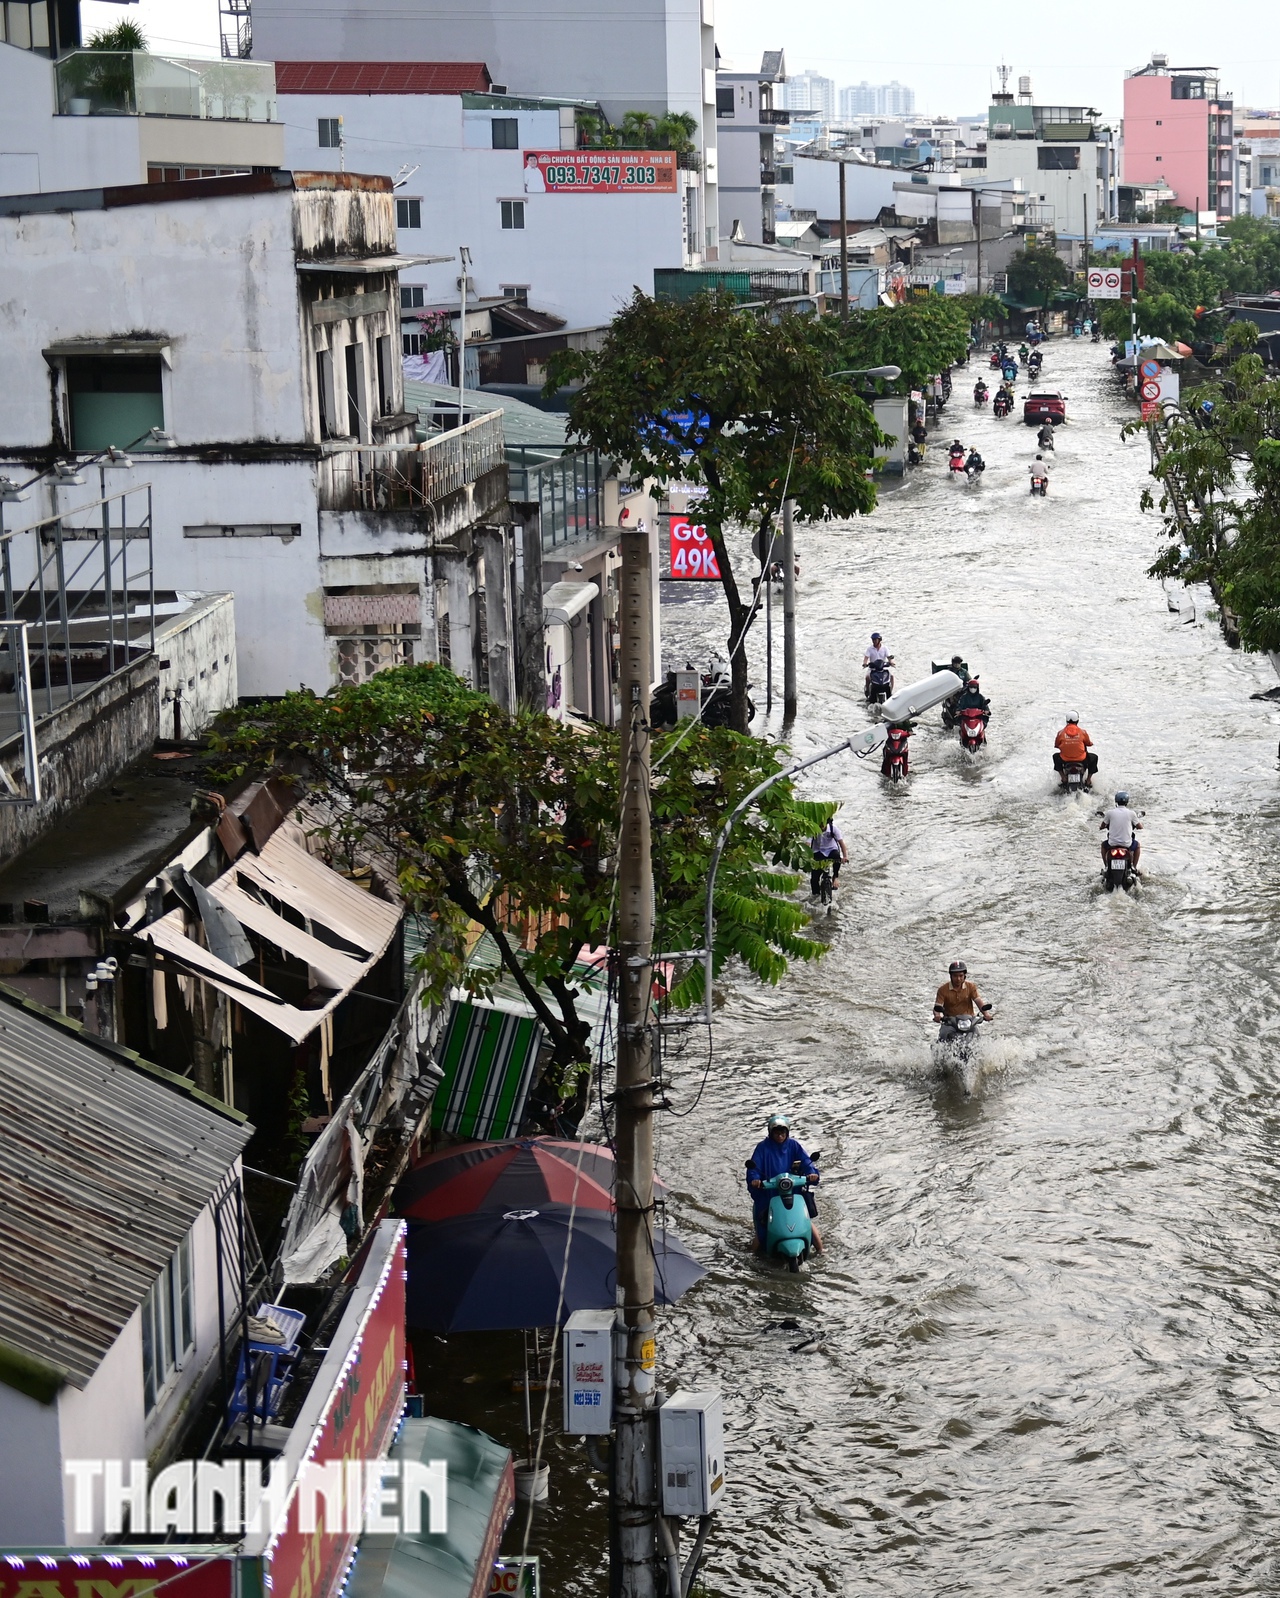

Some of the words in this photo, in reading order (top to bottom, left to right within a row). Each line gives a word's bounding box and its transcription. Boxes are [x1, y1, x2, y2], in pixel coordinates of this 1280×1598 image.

[551, 155, 575, 164] CHUYÊN
[576, 154, 588, 164] BẤT
[589, 155, 606, 165] ĐỘNG
[607, 154, 620, 164] SẢN
[621, 155, 639, 165] QUẬN
[650, 155, 663, 164] NHÀ
[664, 155, 672, 164] BÈ
[547, 166, 656, 184] 093.7347.303
[674, 548, 719, 576] 49K
[364, 1325, 396, 1447] NAM
